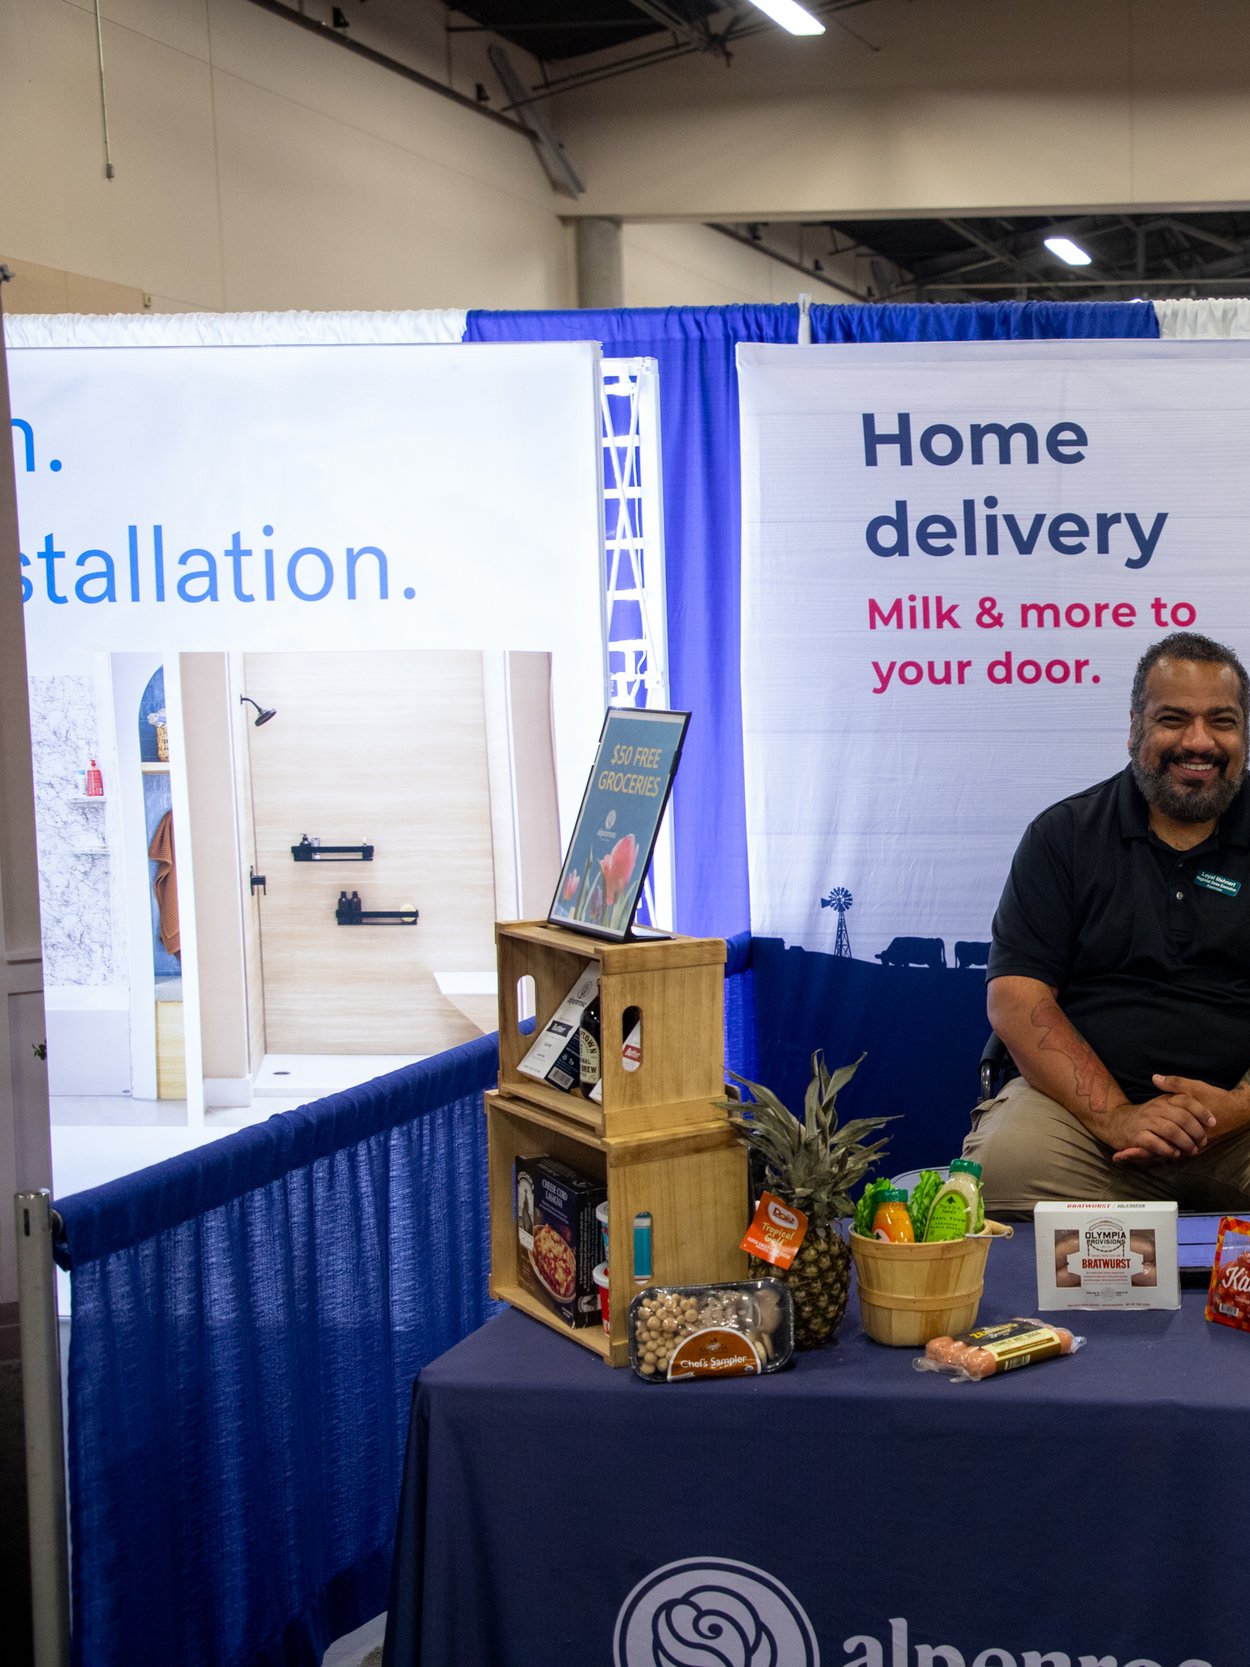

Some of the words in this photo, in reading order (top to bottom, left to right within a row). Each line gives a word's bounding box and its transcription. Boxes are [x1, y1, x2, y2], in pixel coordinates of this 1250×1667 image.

[862, 412, 1088, 466] Home
[866, 495, 1169, 569] delivery
[868, 594, 961, 630] Milk
[975, 596, 1005, 629] &
[1020, 602, 1137, 629] more
[1151, 597, 1196, 628] to
[871, 658, 972, 694] your
[987, 651, 1101, 685] door.
[610, 744, 632, 767] $50
[633, 746, 662, 769] FREE
[598, 770, 661, 797] GROCERIES
[762, 1222, 796, 1240] Tropical
[1085, 1231, 1126, 1239] OLYMPIA
[1082, 1259, 1131, 1269] BRATWURST
[680, 1358, 708, 1369] Chef's
[710, 1354, 747, 1368] Sampler
